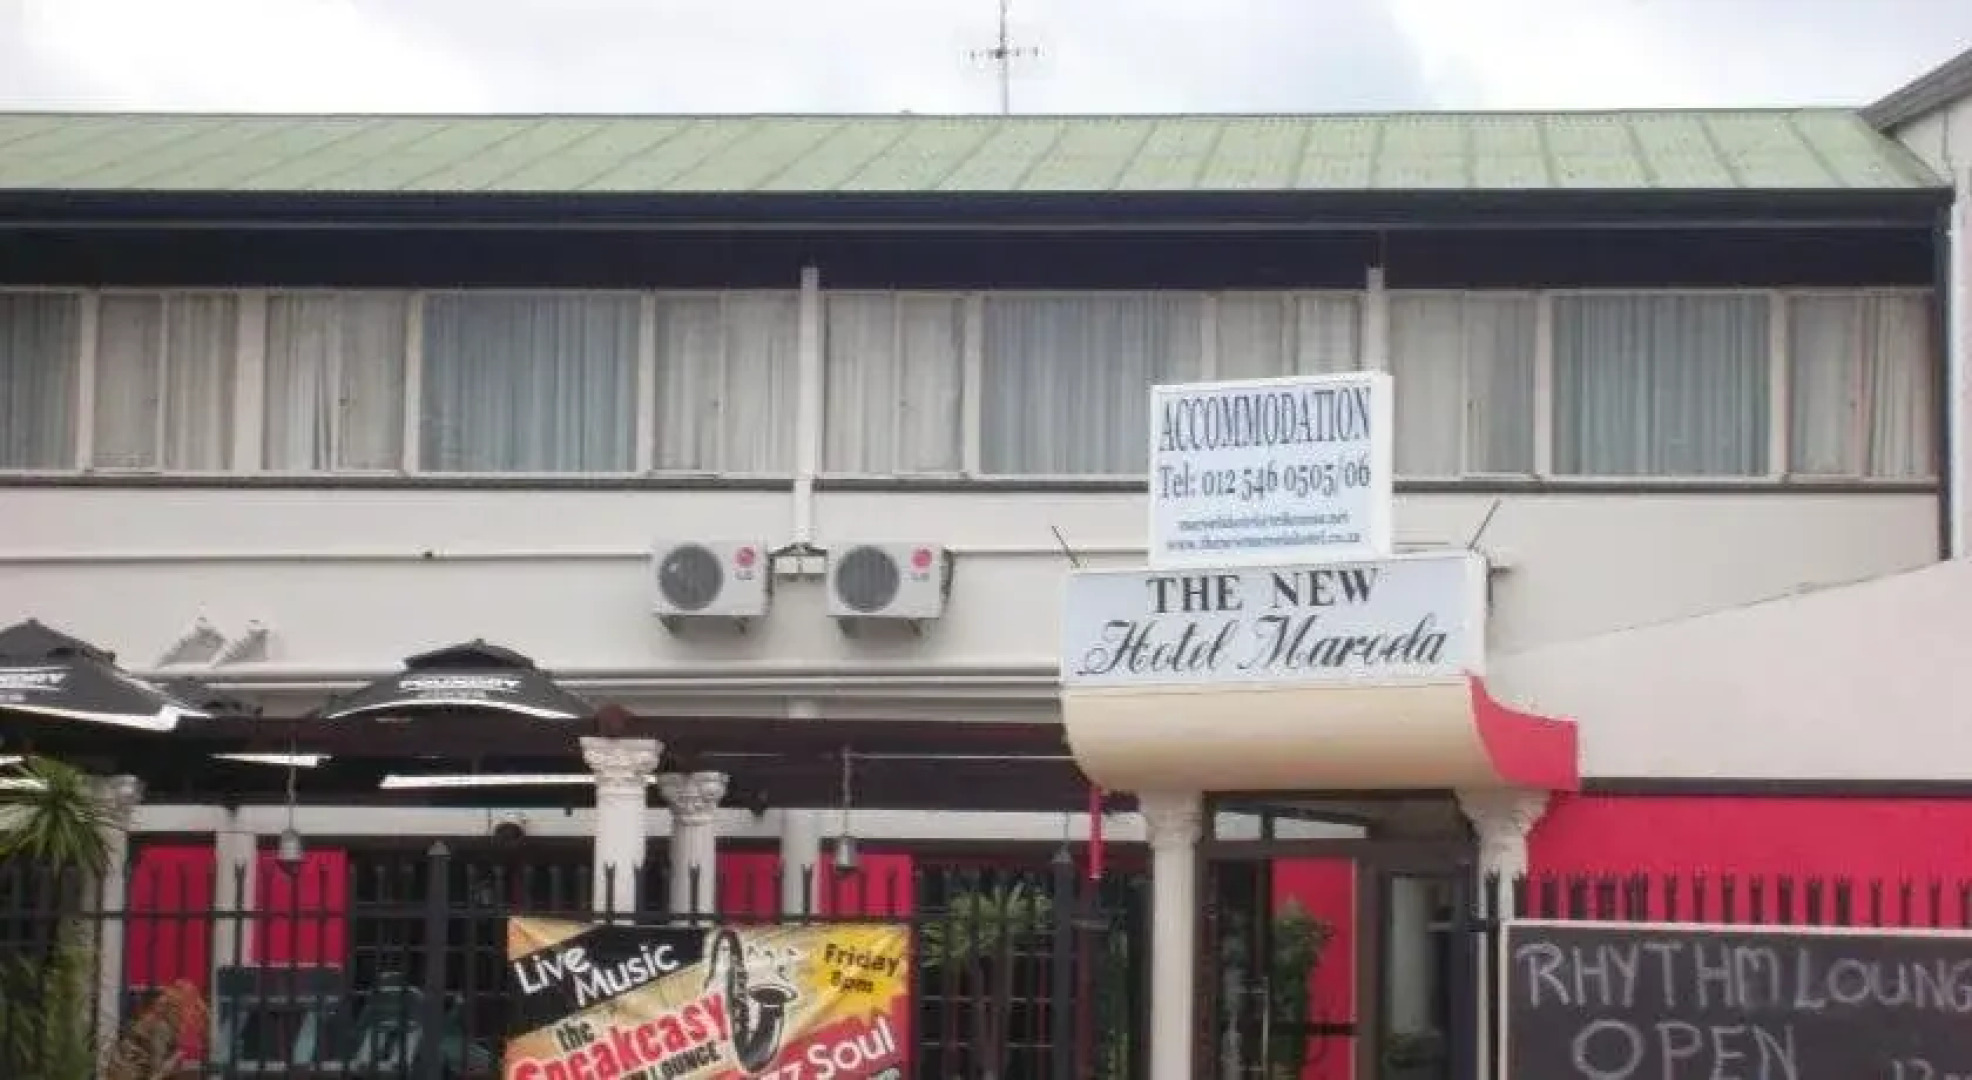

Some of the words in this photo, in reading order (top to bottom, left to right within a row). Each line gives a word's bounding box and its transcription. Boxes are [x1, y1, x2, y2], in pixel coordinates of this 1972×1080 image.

[1159, 387, 1371, 451] ACCOMMODATION
[1159, 460, 1196, 499] Tel:
[1201, 469, 1236, 496] 012
[1241, 460, 1278, 501] 546
[1146, 574, 1243, 614] THE
[1270, 567, 1378, 609] NEW
[1076, 618, 1240, 677] Hotel
[513, 946, 592, 995] Live
[572, 942, 680, 1006] Music
[825, 943, 900, 978] Friday
[1515, 940, 1781, 1008] RHYTHM
[556, 1021, 595, 1051] the
[807, 1015, 896, 1080] Soul
[1572, 1019, 1799, 1080] OPEN
